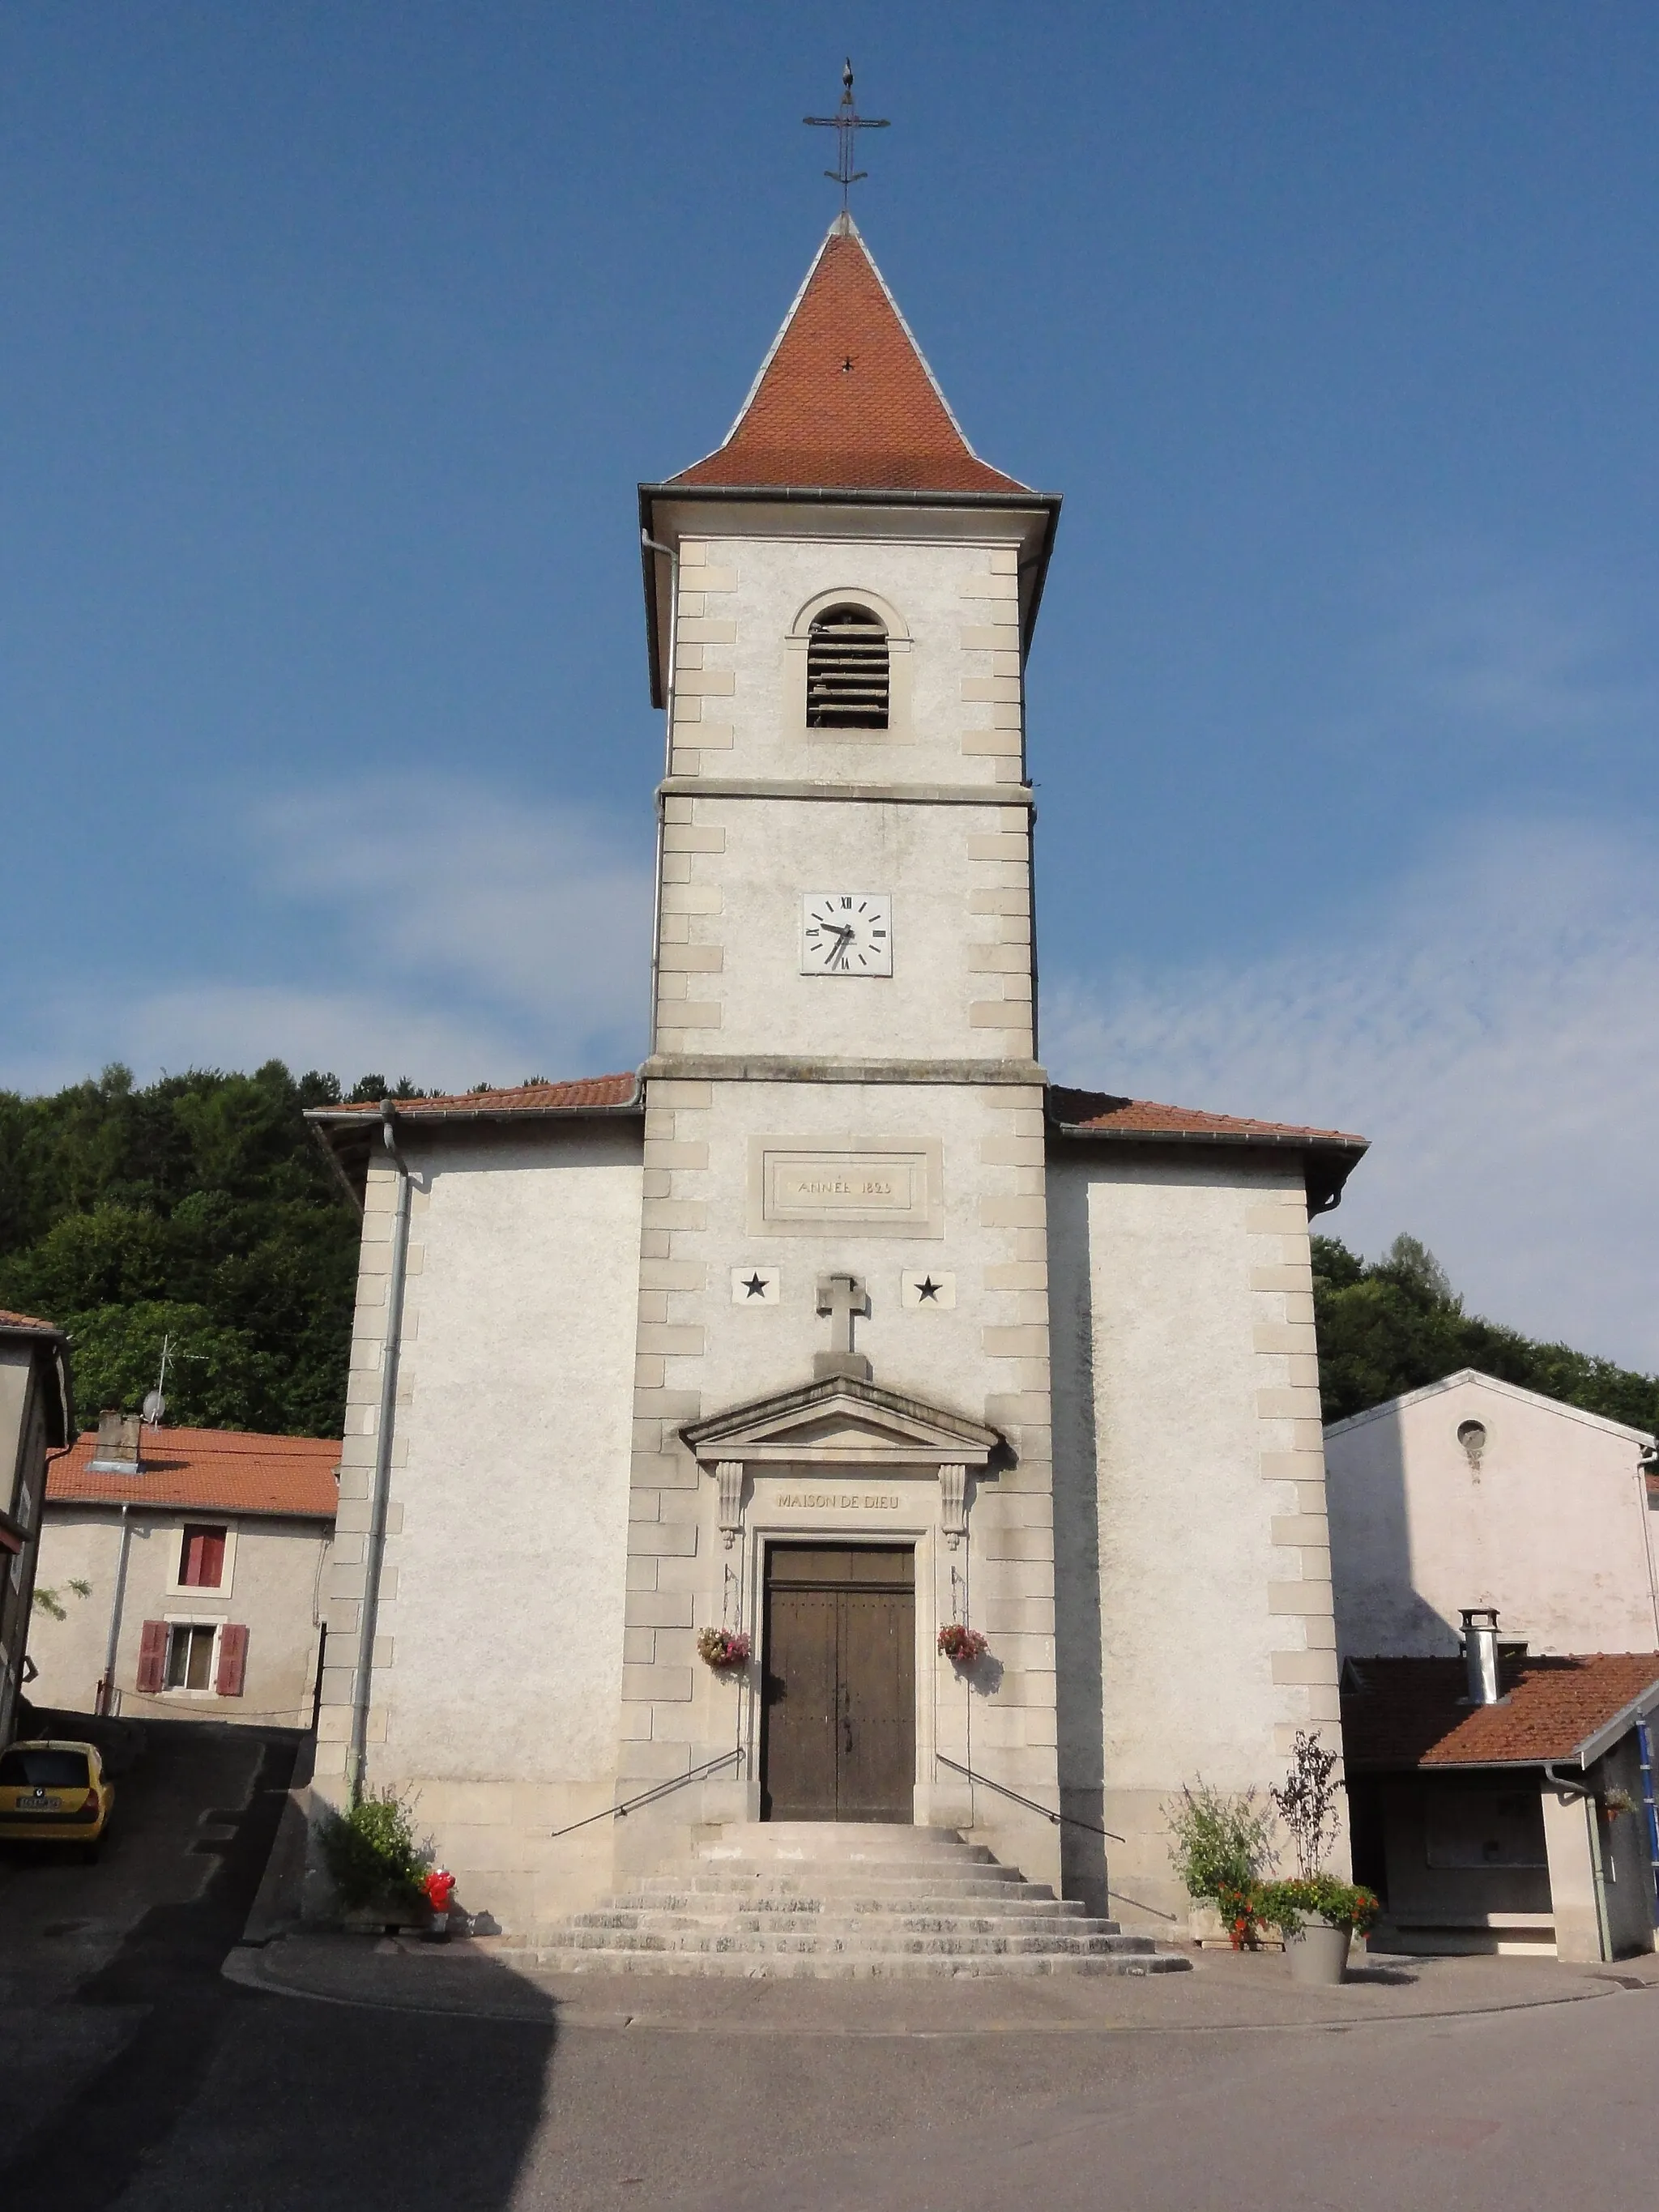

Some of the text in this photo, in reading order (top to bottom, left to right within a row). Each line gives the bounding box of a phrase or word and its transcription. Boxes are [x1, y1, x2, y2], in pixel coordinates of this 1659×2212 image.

[778, 1494, 899, 1510] MAISON DE DIEU
